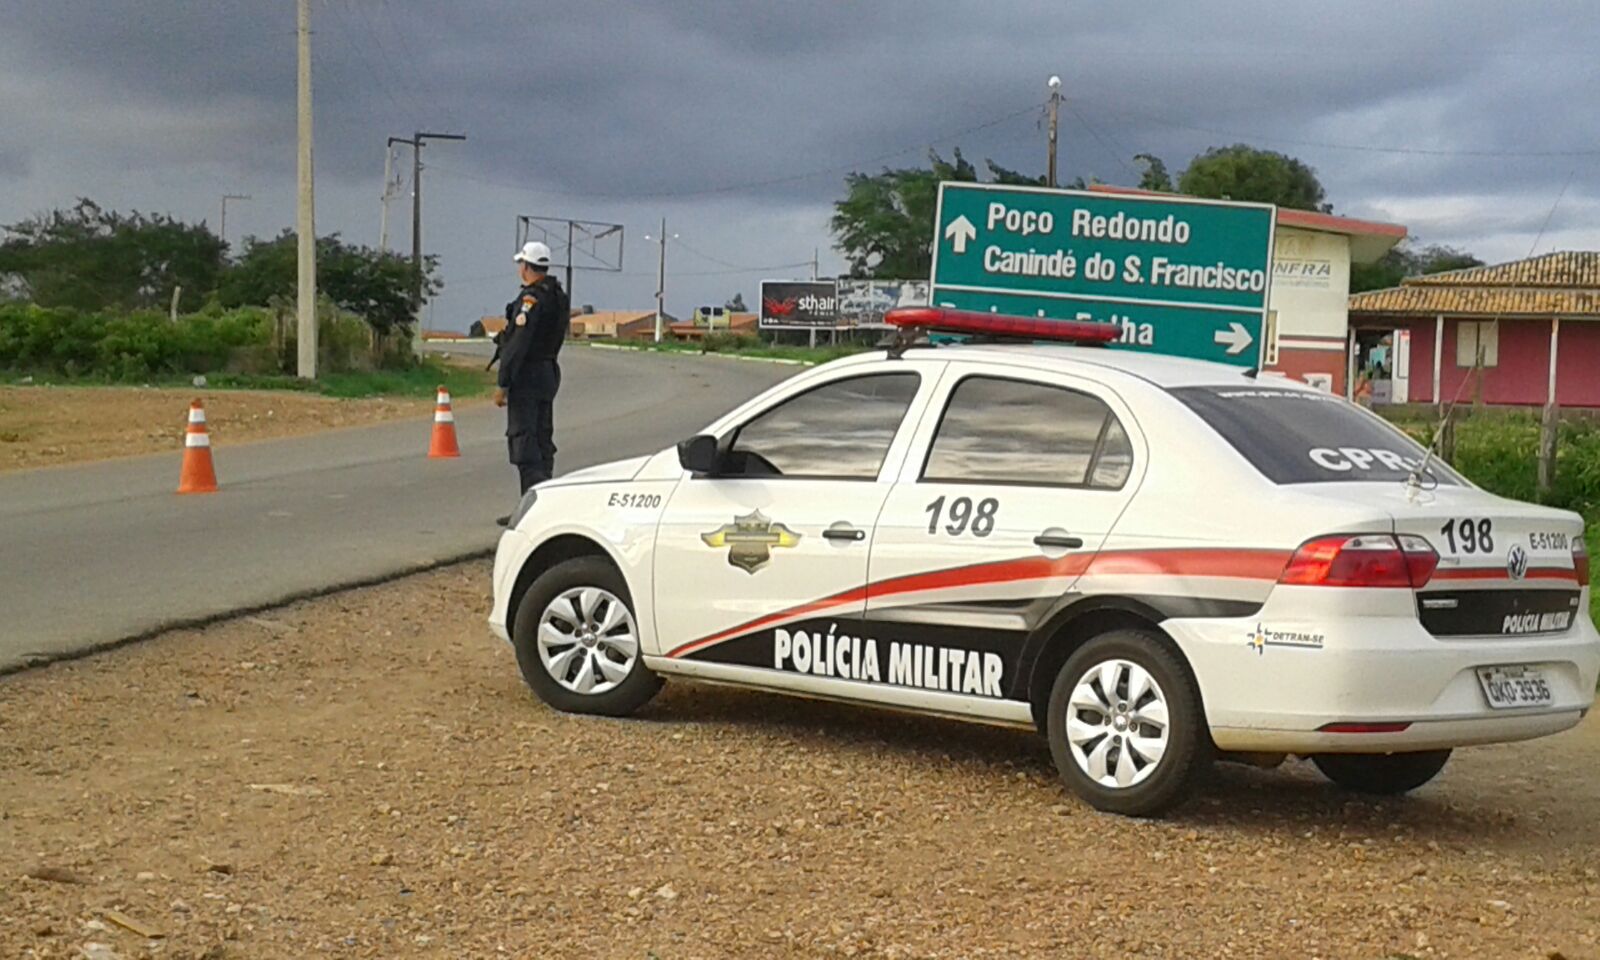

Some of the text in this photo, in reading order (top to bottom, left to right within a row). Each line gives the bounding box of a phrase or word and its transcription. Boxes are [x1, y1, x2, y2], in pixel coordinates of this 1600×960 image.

[987, 202, 1190, 244] Poço Redondo
[984, 244, 1265, 292] Canindé do S. Francisco
[1274, 262, 1331, 276] NFRA
[607, 492, 662, 509] E-51200
[924, 495, 1000, 538] 198
[1440, 517, 1494, 554] 198
[1529, 532, 1568, 550] E-51200
[1272, 631, 1325, 643] DETRAN-SE
[1502, 609, 1539, 634] POLÍCIA
[774, 622, 1004, 697] POLÍCIA MILITAR
